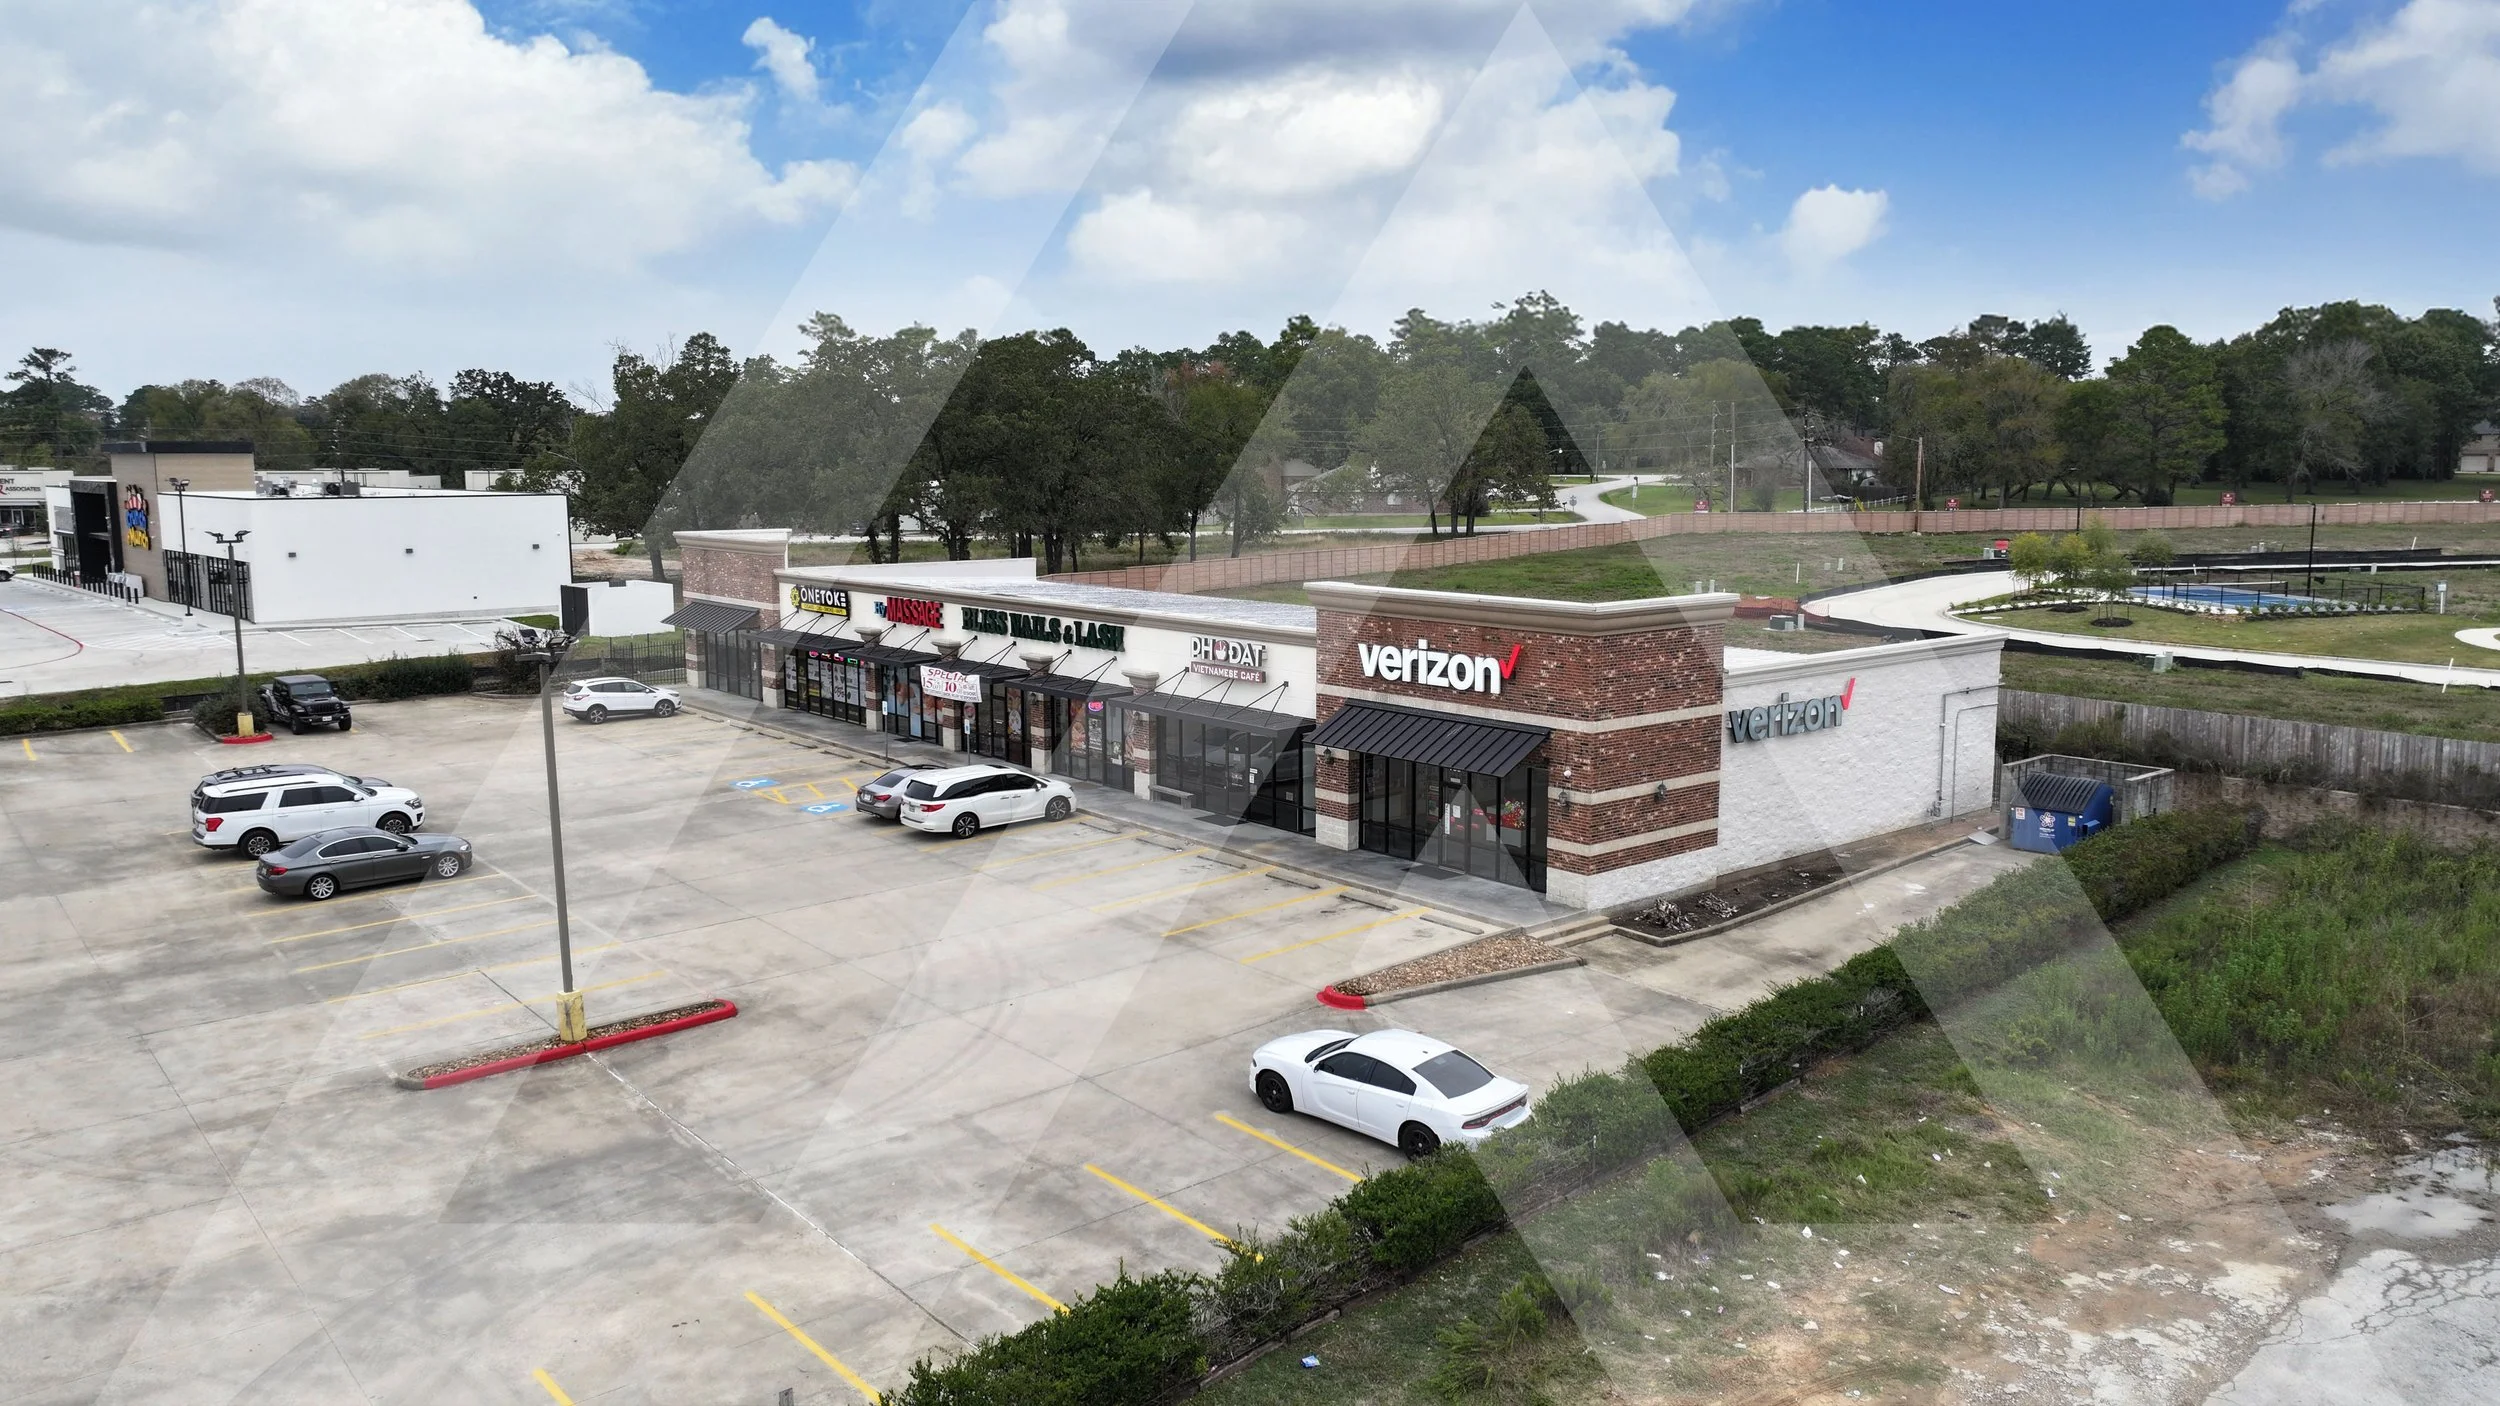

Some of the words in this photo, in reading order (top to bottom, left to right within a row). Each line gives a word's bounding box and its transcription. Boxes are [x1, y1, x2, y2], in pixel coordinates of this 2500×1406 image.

[886, 596, 944, 629] MASSAGE
[961, 606, 1008, 635] BLISS
[1009, 612, 1061, 643] NAILS
[1063, 624, 1073, 644] &
[1073, 620, 1125, 652] LASH
[1192, 663, 1239, 679] VIETNAMESE
[1240, 671, 1260, 682] CAFÉ
[1357, 638, 1501, 695] verizon
[944, 681, 957, 693] 10
[1728, 692, 1844, 744] verizon
